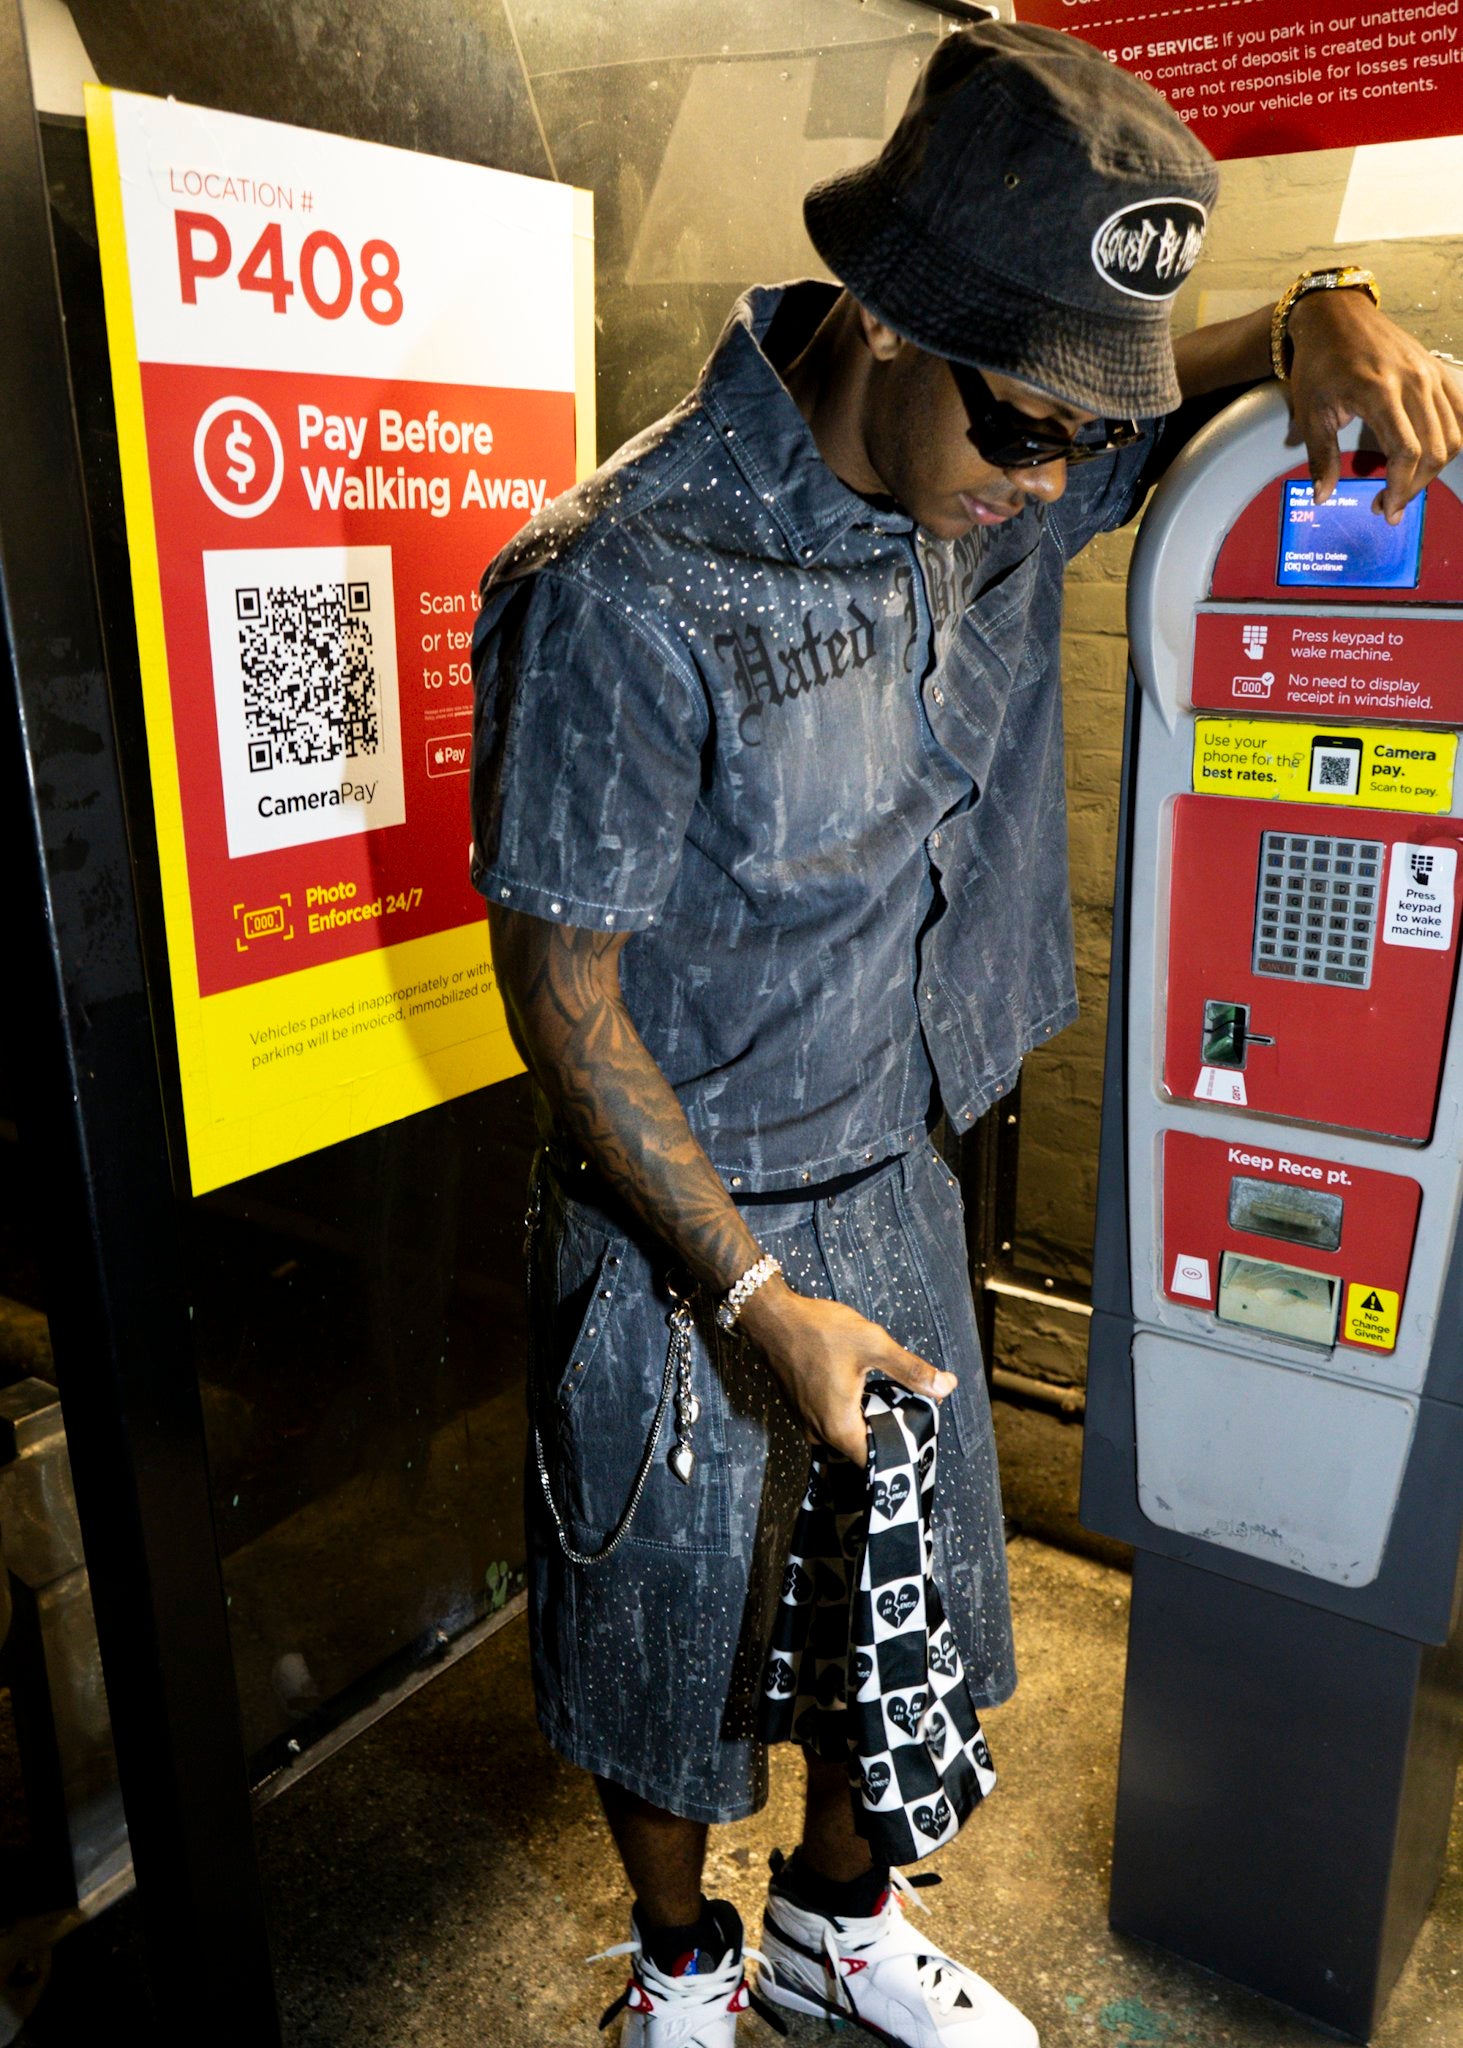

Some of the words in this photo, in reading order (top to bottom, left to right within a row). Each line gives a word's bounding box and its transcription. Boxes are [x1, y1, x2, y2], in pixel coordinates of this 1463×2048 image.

[1121, 45, 1143, 61] OF
[1147, 35, 1219, 58] SERVICE:
[1222, 31, 1232, 46] If
[1237, 30, 1265, 48] you
[1270, 22, 1305, 42] park
[1309, 19, 1324, 34] in
[1328, 16, 1356, 32] our
[1361, 1, 1459, 27] unattended
[1134, 70, 1153, 81] no
[1157, 57, 1217, 79] contract
[1222, 54, 1237, 70] of
[1242, 47, 1299, 68] deposit
[1304, 45, 1317, 59] is
[1321, 34, 1382, 56] created
[1387, 32, 1416, 48] but
[1421, 25, 1457, 43] only
[1171, 86, 1195, 100] are
[1200, 80, 1225, 96] not
[1230, 68, 1322, 91] responsible
[1327, 64, 1351, 79] for
[1357, 57, 1408, 76] losses
[1202, 104, 1218, 118] to
[1222, 100, 1255, 118] your
[1260, 92, 1313, 110] vehicle
[1317, 91, 1334, 104] or
[1339, 86, 1358, 101] its
[1362, 78, 1438, 99] contents.
[170, 167, 293, 210] LOCATION
[300, 191, 314, 213] #
[174, 209, 404, 326] P408
[298, 404, 368, 460] Pay
[379, 408, 494, 455] Before
[300, 465, 450, 518] Walking
[460, 469, 551, 517] Away.
[1285, 551, 1314, 562] [Cancel]
[1315, 552, 1324, 561] to
[1325, 552, 1348, 561] Delete
[1284, 562, 1301, 572] [OK]
[1302, 563, 1311, 571] to
[1311, 562, 1343, 571] Continue
[420, 591, 465, 615] Scan
[421, 633, 442, 653] or
[1292, 628, 1328, 644] Press
[1332, 630, 1384, 647] keypad
[1388, 633, 1404, 646] to
[1290, 646, 1326, 659] wake
[1330, 648, 1393, 662] machine.
[423, 668, 443, 690] to
[448, 662, 473, 687] 50
[714, 597, 877, 746] Hated
[1288, 674, 1308, 687] No
[1312, 675, 1347, 689] need
[1350, 677, 1365, 690] to
[1369, 678, 1420, 694] display
[1287, 691, 1335, 705] receipt
[1338, 693, 1350, 705] in
[1353, 695, 1433, 710] windshield.
[1204, 733, 1230, 747] Use
[1234, 737, 1267, 751] your
[444, 746, 466, 764] Pay
[1203, 750, 1248, 766] phone
[1252, 752, 1272, 765] for
[1276, 755, 1300, 769] the
[1373, 745, 1436, 761] Camera
[1202, 766, 1233, 779] best
[1237, 769, 1277, 783] rates.
[1371, 764, 1405, 777] pay.
[258, 781, 378, 818] CameraPay
[1370, 782, 1396, 793] Scan
[1400, 783, 1412, 794] to
[1415, 785, 1438, 798] pay.
[306, 881, 357, 907] Photo
[1339, 885, 1346, 894] D
[1406, 888, 1436, 900] Press
[307, 897, 382, 934] Enforced
[386, 887, 424, 913] 24/7
[1398, 900, 1441, 913] keypad
[1312, 917, 1320, 926] M
[1335, 920, 1341, 928] N
[1396, 913, 1408, 922] to
[1411, 915, 1442, 926] wake
[1312, 933, 1318, 941] R
[1335, 937, 1341, 945] S
[1357, 940, 1364, 948] T
[1391, 926, 1443, 939] machine.
[1308, 951, 1318, 959] W
[1308, 968, 1314, 976] Z
[1336, 972, 1352, 981] OK
[249, 1020, 307, 1045] Vehicles
[309, 1002, 355, 1030] parked
[358, 975, 449, 1013] inappropriately
[451, 971, 464, 983] or
[251, 1042, 304, 1070] parking
[307, 1031, 328, 1049] will
[332, 1026, 348, 1041] be
[351, 1007, 407, 1036] invoiced,
[409, 984, 478, 1017] immobilized
[481, 981, 492, 993] or
[1228, 1148, 1274, 1171] Keep
[1352, 1318, 1390, 1334] Change
[1364, 1312, 1379, 1322] No
[1354, 1328, 1385, 1342] Given.
